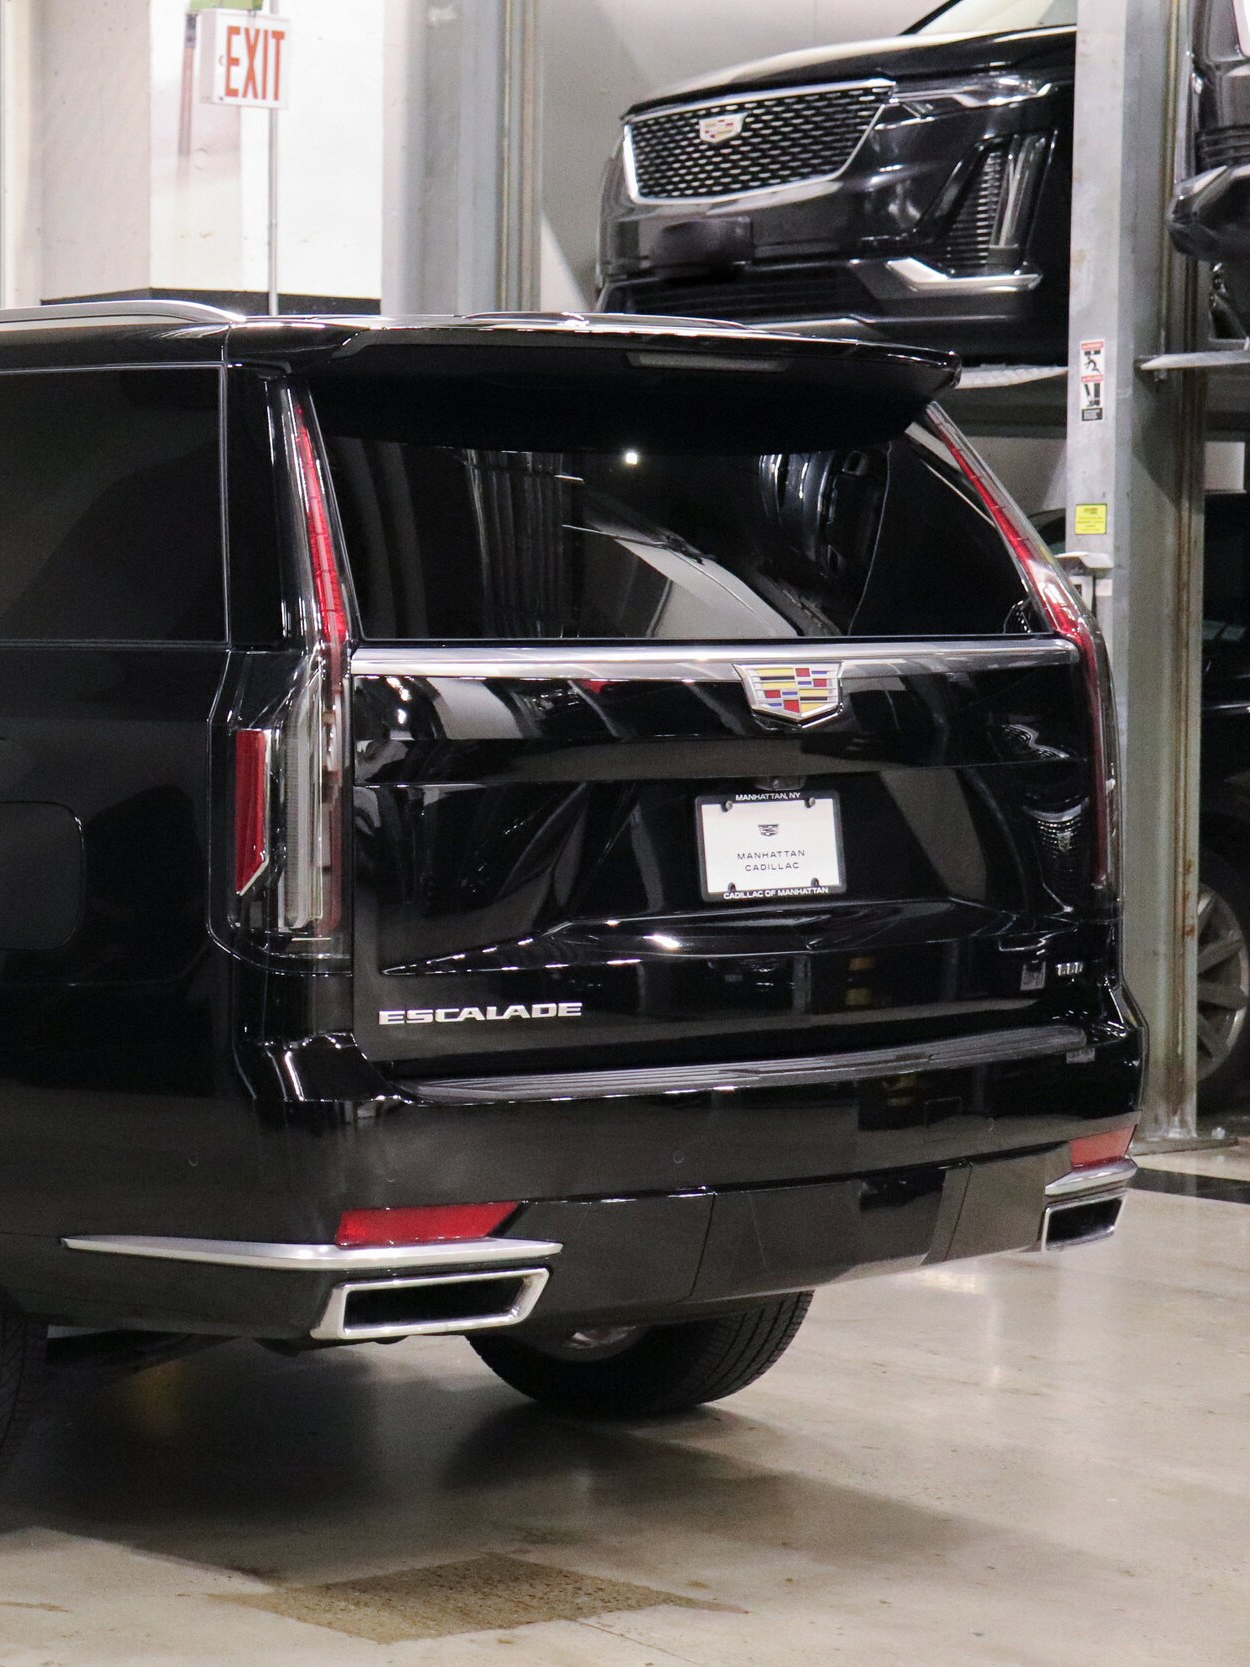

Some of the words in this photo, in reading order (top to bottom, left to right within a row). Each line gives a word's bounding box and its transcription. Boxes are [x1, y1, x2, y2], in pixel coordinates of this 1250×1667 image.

[225, 25, 285, 101] EXIT
[735, 792, 788, 801] MANHATTAN,
[737, 850, 805, 860] MANHATTAN
[745, 862, 800, 872] CADILLAC
[723, 889, 764, 900] CADILLAC
[765, 889, 776, 897] OF
[777, 887, 829, 896] MANHATTAN
[378, 1002, 583, 1025] ESCALADE
